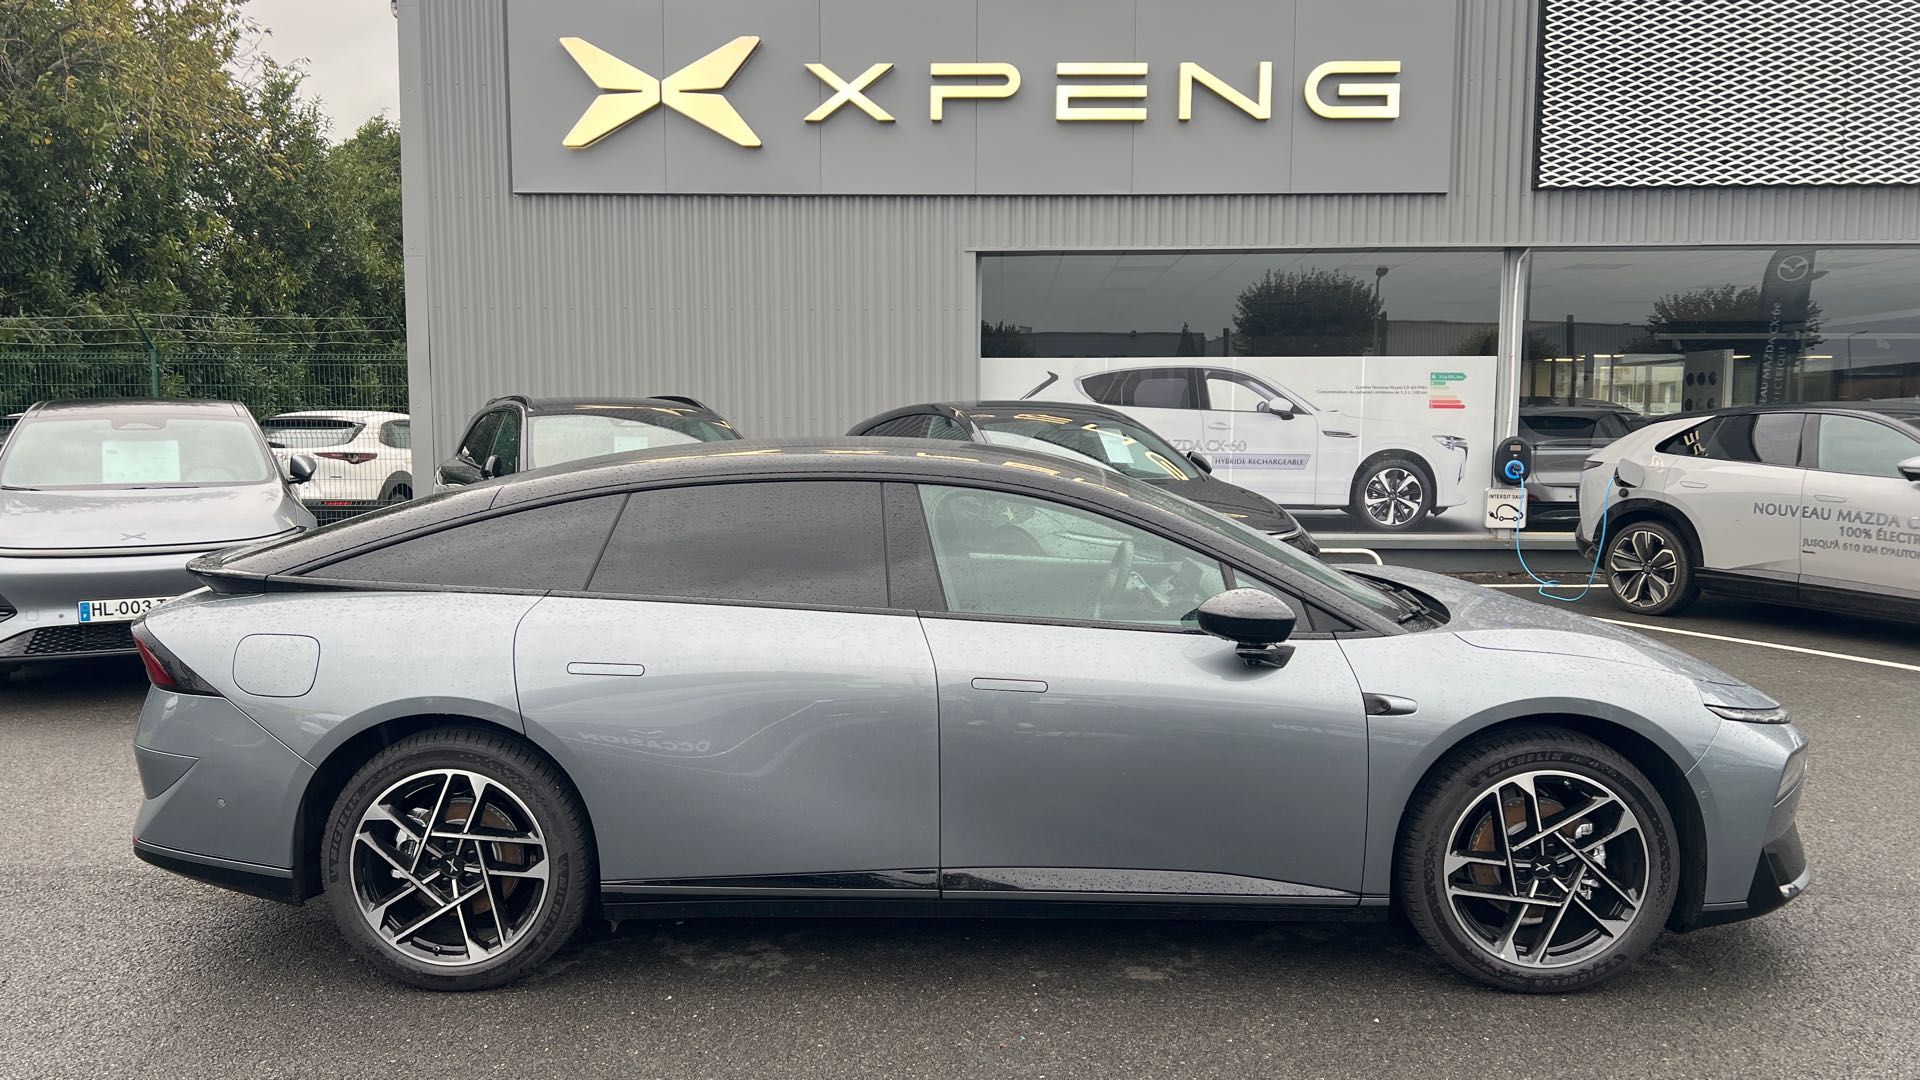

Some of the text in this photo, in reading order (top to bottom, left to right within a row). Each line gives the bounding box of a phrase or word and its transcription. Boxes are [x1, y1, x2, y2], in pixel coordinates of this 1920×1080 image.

[804, 60, 1402, 123] XPENG
[1761, 337, 1776, 379] MAZDA
[1166, 439, 1248, 453] ZDA CX-60
[1215, 458, 1304, 467] HYBRIDE RECHARGEABLE
[1753, 502, 1832, 521] NOUVEAU
[1836, 509, 1901, 528] MAZDA
[1839, 525, 1873, 540] 100%
[1801, 537, 1841, 550] JUSQU'À
[1842, 543, 1861, 552] 610
[1862, 545, 1878, 555] KM
[91, 599, 166, 616] HL-003
[1487, 752, 1563, 777] MICHELIN
